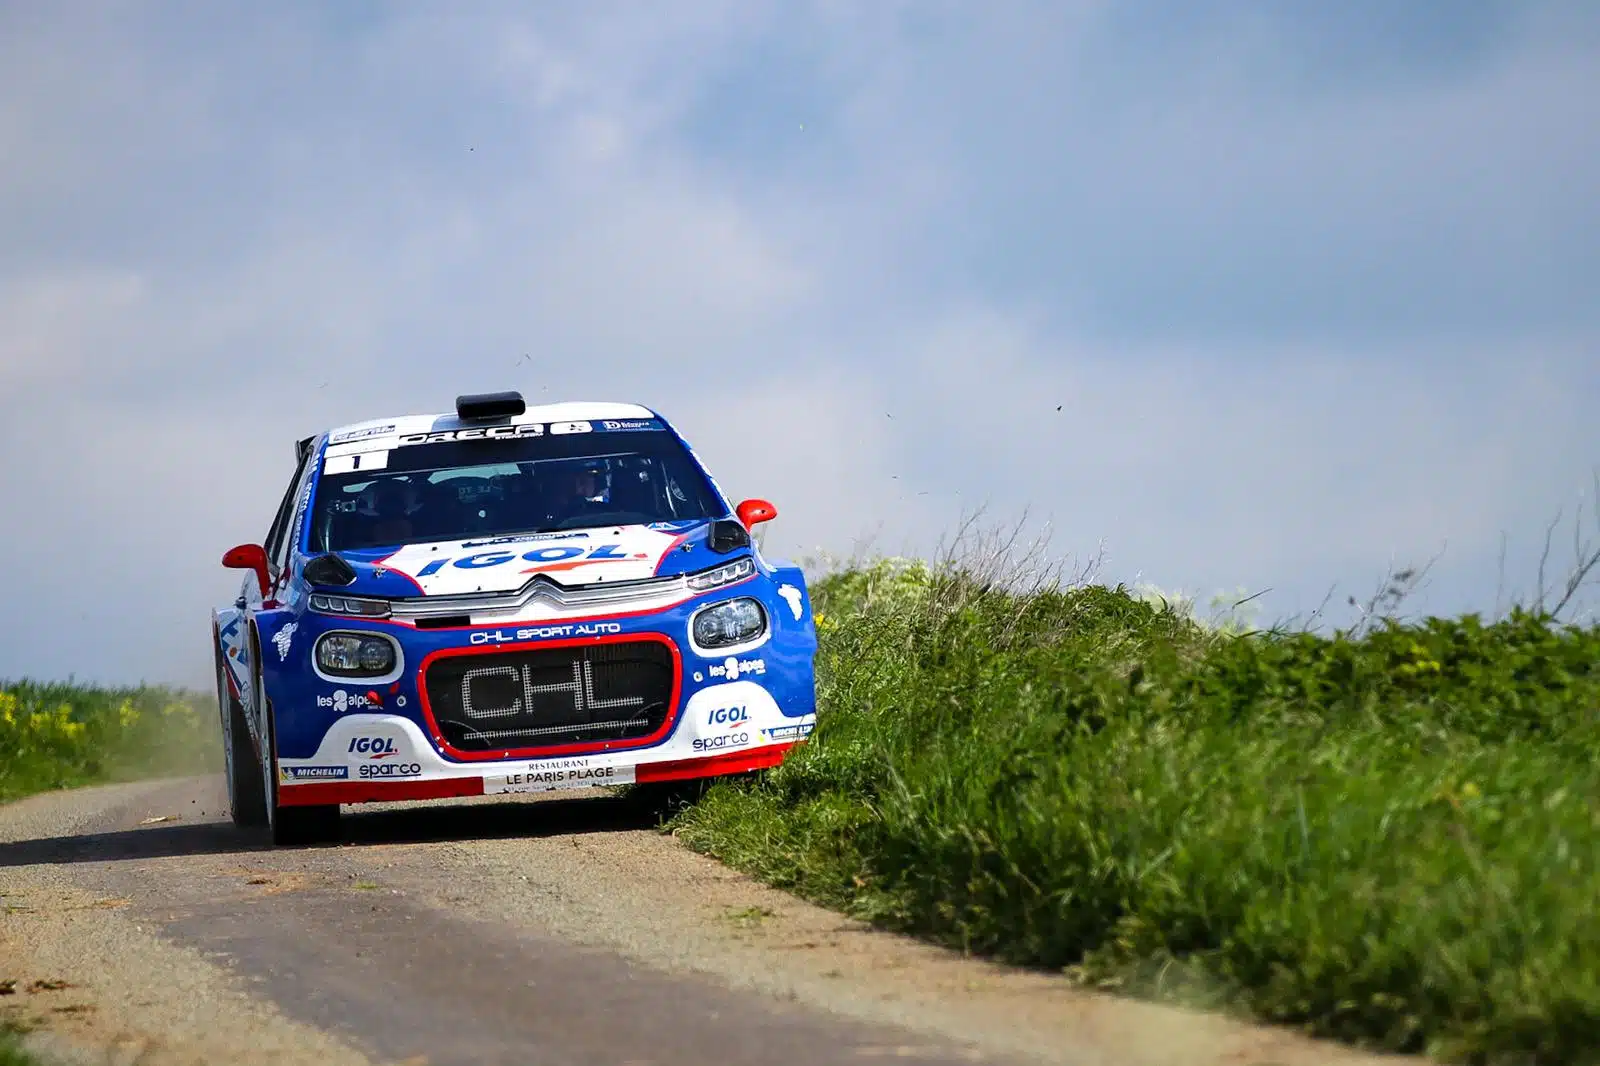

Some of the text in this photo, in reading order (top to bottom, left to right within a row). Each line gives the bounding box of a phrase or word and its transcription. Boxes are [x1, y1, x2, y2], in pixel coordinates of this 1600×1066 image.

[399, 424, 544, 444] ORECA
[352, 455, 361, 469] 1
[470, 622, 621, 645] CHL SPORT AUTO
[462, 660, 644, 719] CHL
[317, 694, 333, 707] les
[692, 732, 749, 751] sparco
[297, 768, 345, 777] MICHELIN
[359, 763, 421, 779] sparco
[528, 758, 589, 770] RESTAURANT
[506, 767, 614, 785] LE PARIS PLAGE
